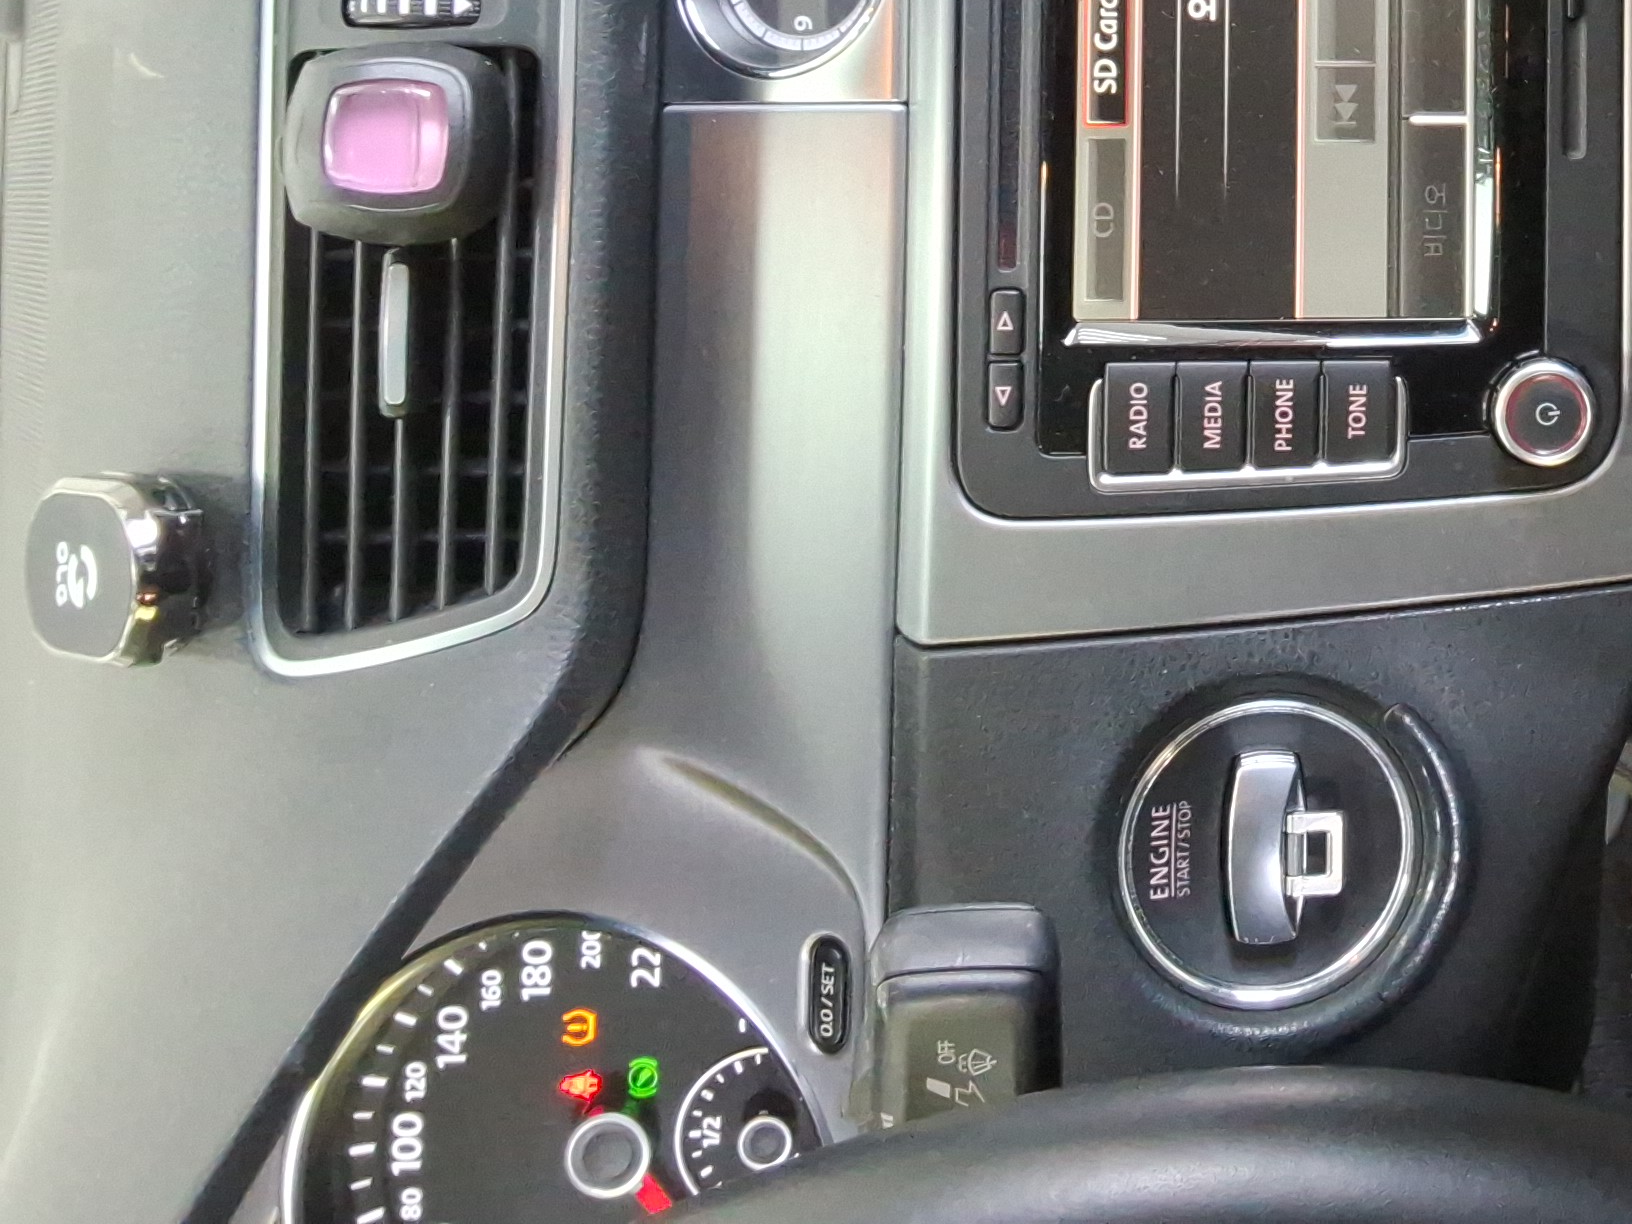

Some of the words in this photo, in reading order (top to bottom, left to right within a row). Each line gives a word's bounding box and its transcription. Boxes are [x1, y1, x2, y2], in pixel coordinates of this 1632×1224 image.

[793, 15, 813, 32] 9
[1093, 57, 1118, 95] SD
[1092, 200, 1115, 239] CD
[1419, 183, 1448, 257] 비디오
[1128, 381, 1149, 449] RADIO
[1203, 380, 1223, 449] MEDIA
[1273, 379, 1295, 452] PHONE
[1347, 384, 1368, 439] TONE
[1149, 805, 1171, 900] ENGINE
[480, 969, 503, 1011] 160
[520, 939, 553, 1002] 180
[435, 1005, 469, 1069] 140
[936, 1039, 957, 1065] OFF
[404, 1061, 427, 1102] 120
[390, 1111, 424, 1177] 100
[697, 1116, 722, 1149] 1/2
[399, 1186, 423, 1221] 80
